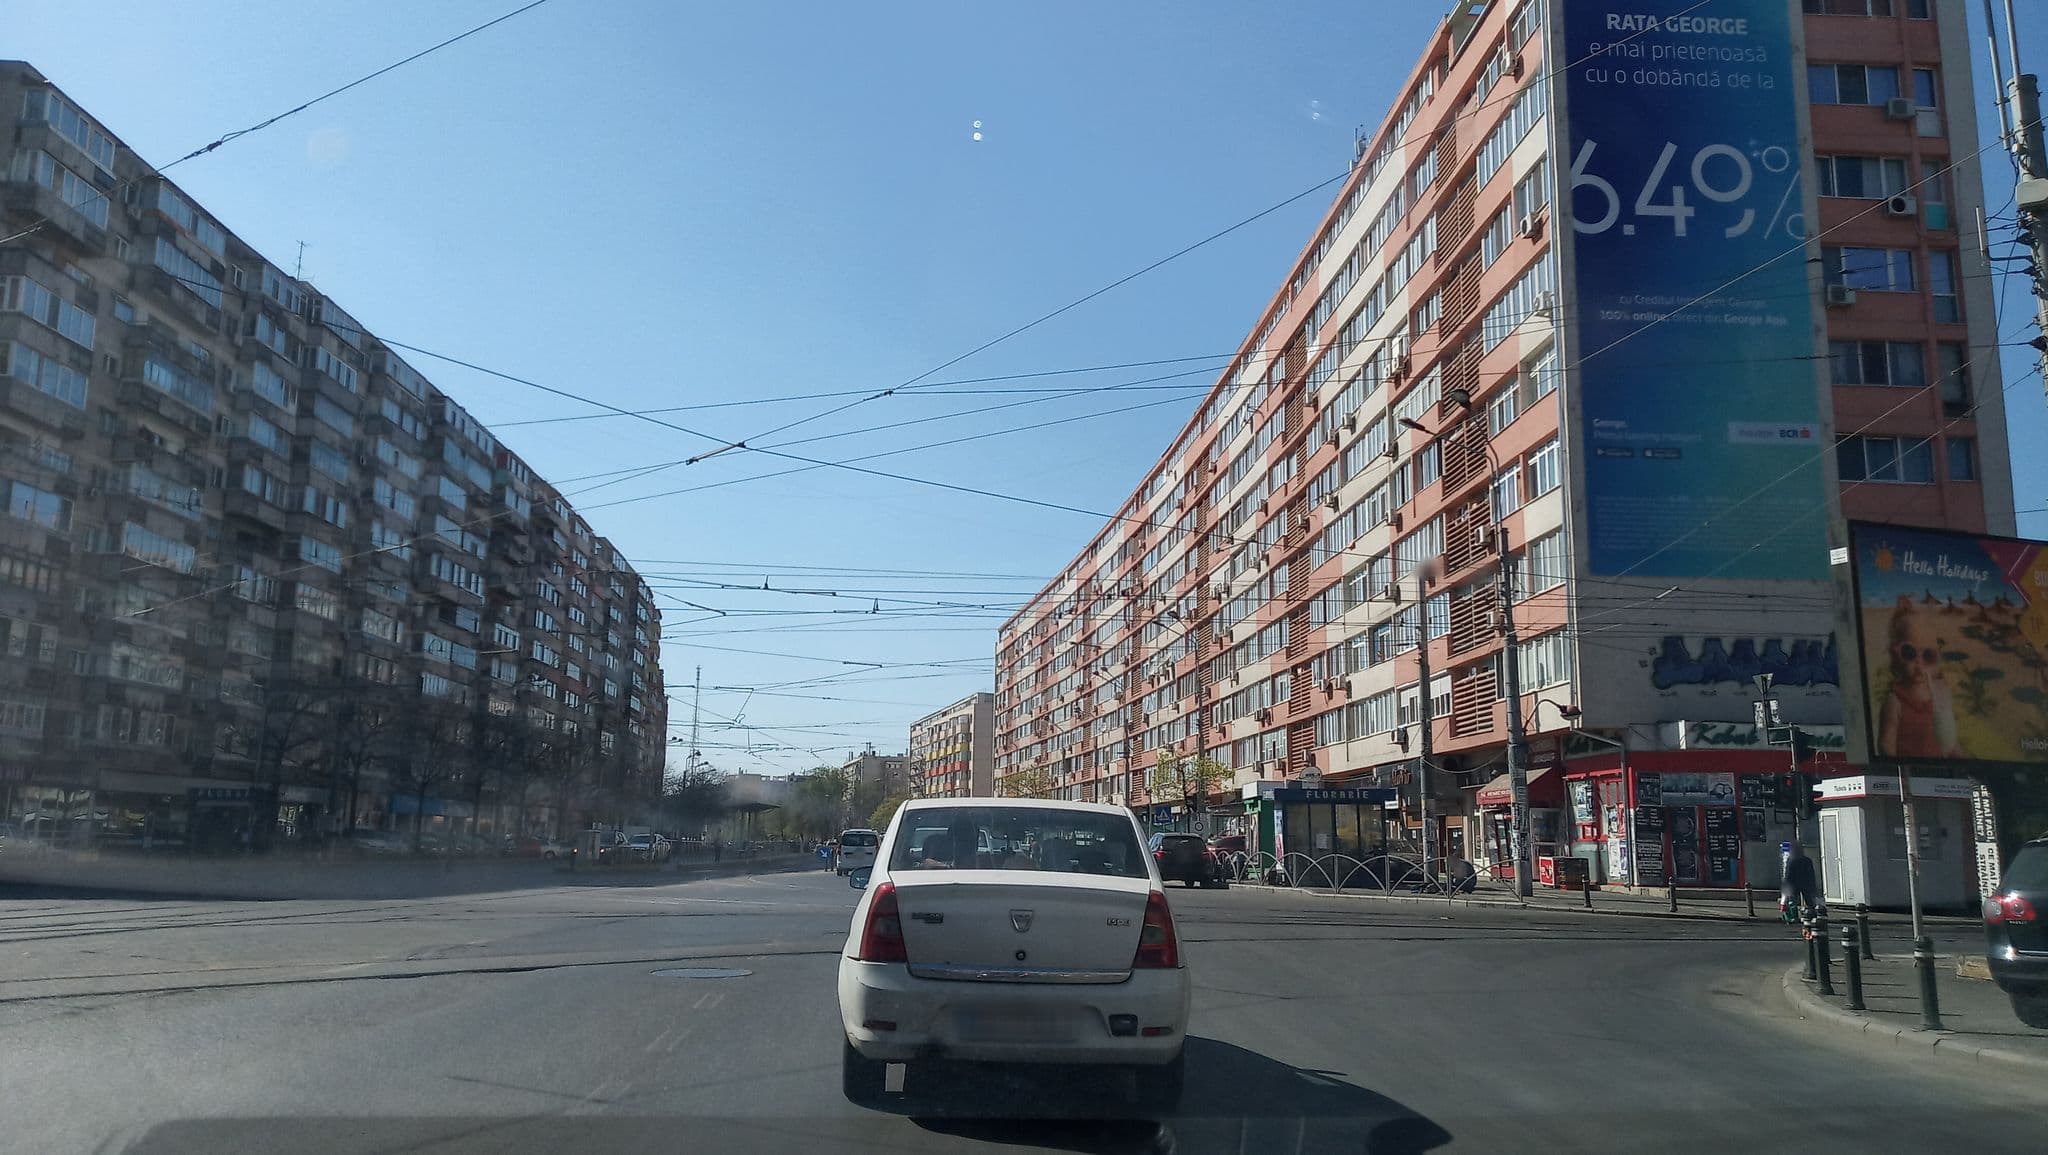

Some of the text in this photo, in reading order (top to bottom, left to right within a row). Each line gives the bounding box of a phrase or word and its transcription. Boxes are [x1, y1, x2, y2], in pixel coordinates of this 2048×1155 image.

[1606, 13, 1748, 36] RATA GEORGE
[1590, 41, 1601, 55] e
[1607, 40, 1645, 58] mai
[1585, 67, 1608, 83] cu
[1614, 69, 1627, 84] o
[1727, 71, 1752, 88] de
[1758, 72, 1775, 89] la
[1779, 429, 1798, 439] BCR
[1903, 550, 1989, 593] Hello Holidays
[1306, 790, 1369, 799] FLORARIE
